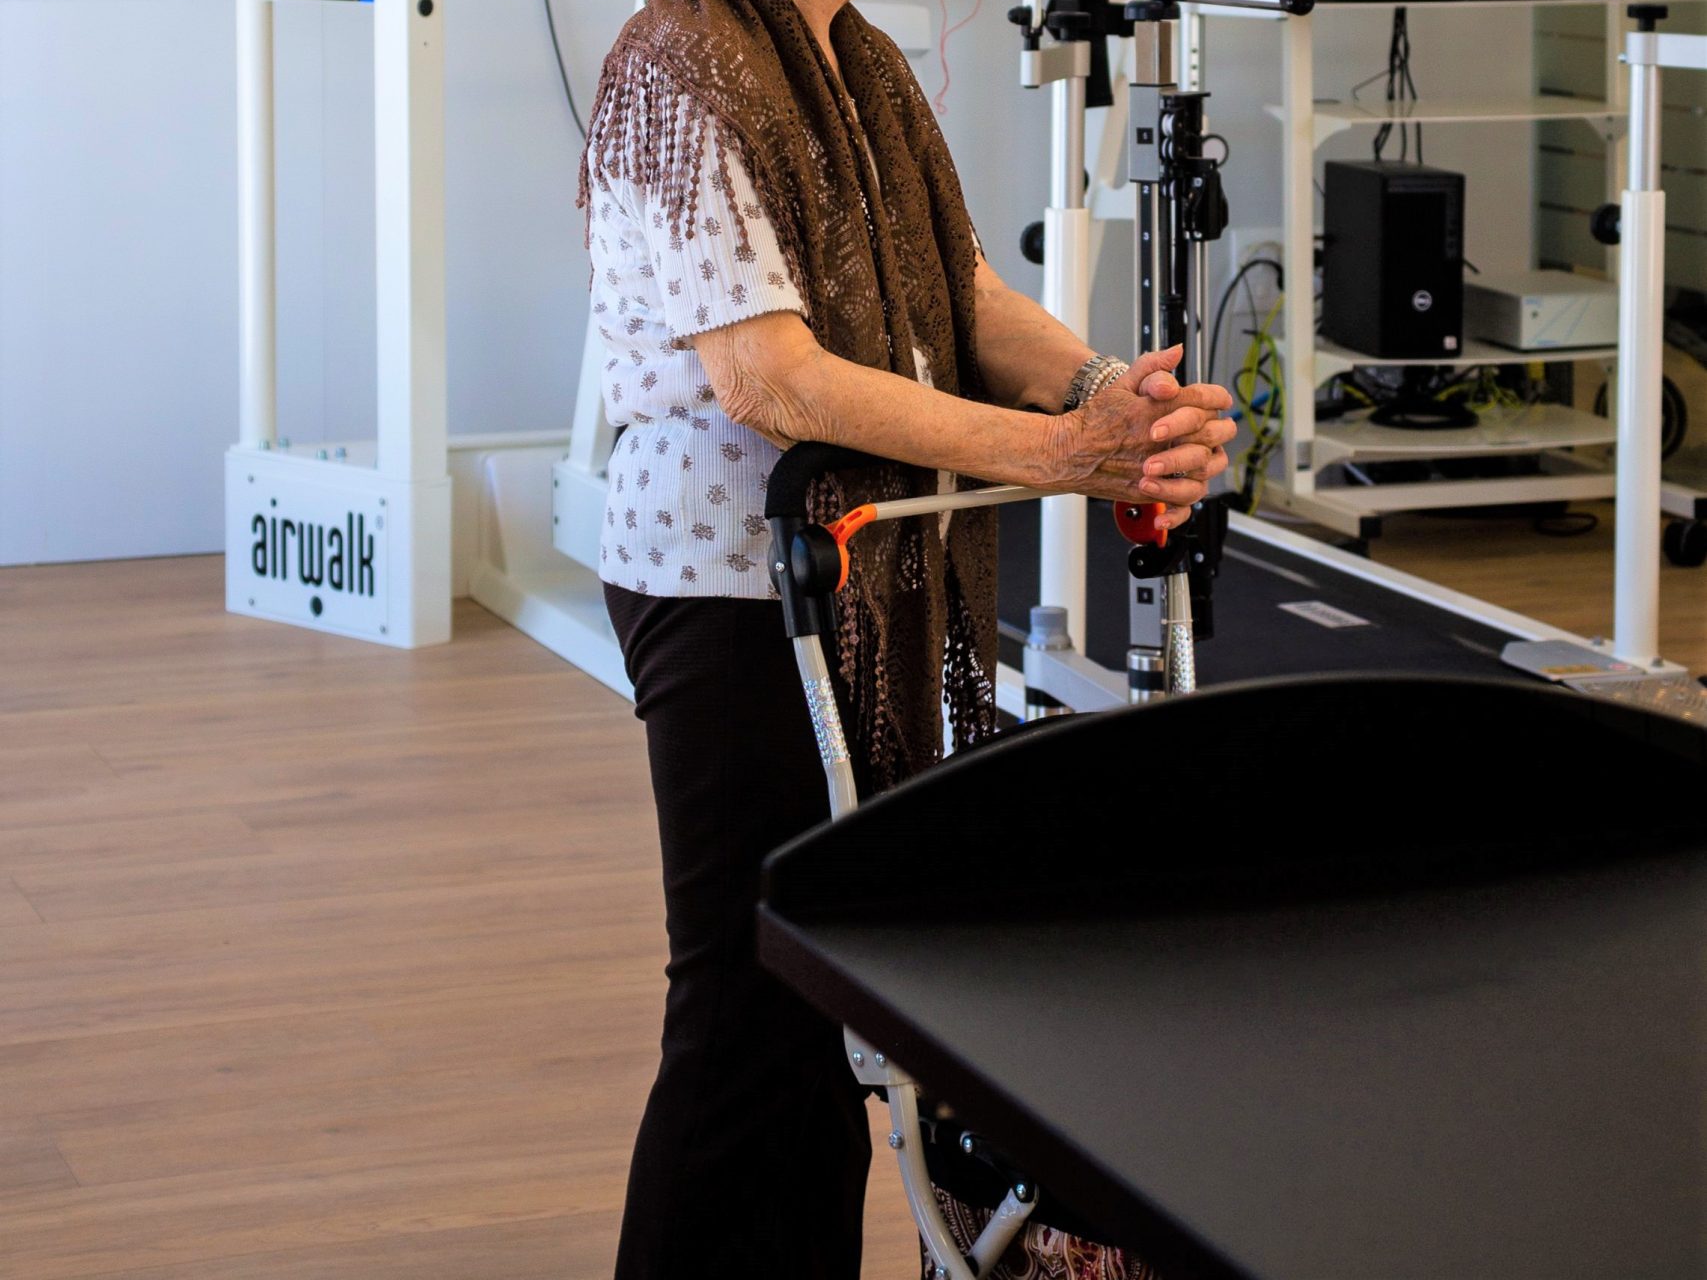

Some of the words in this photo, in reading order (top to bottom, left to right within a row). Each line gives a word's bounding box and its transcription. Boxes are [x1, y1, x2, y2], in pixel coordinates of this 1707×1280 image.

[1142, 184, 1150, 195] 2
[1142, 231, 1150, 241] 3
[1142, 278, 1150, 288] 4
[1142, 324, 1150, 335] 5
[251, 497, 375, 598] airwalk
